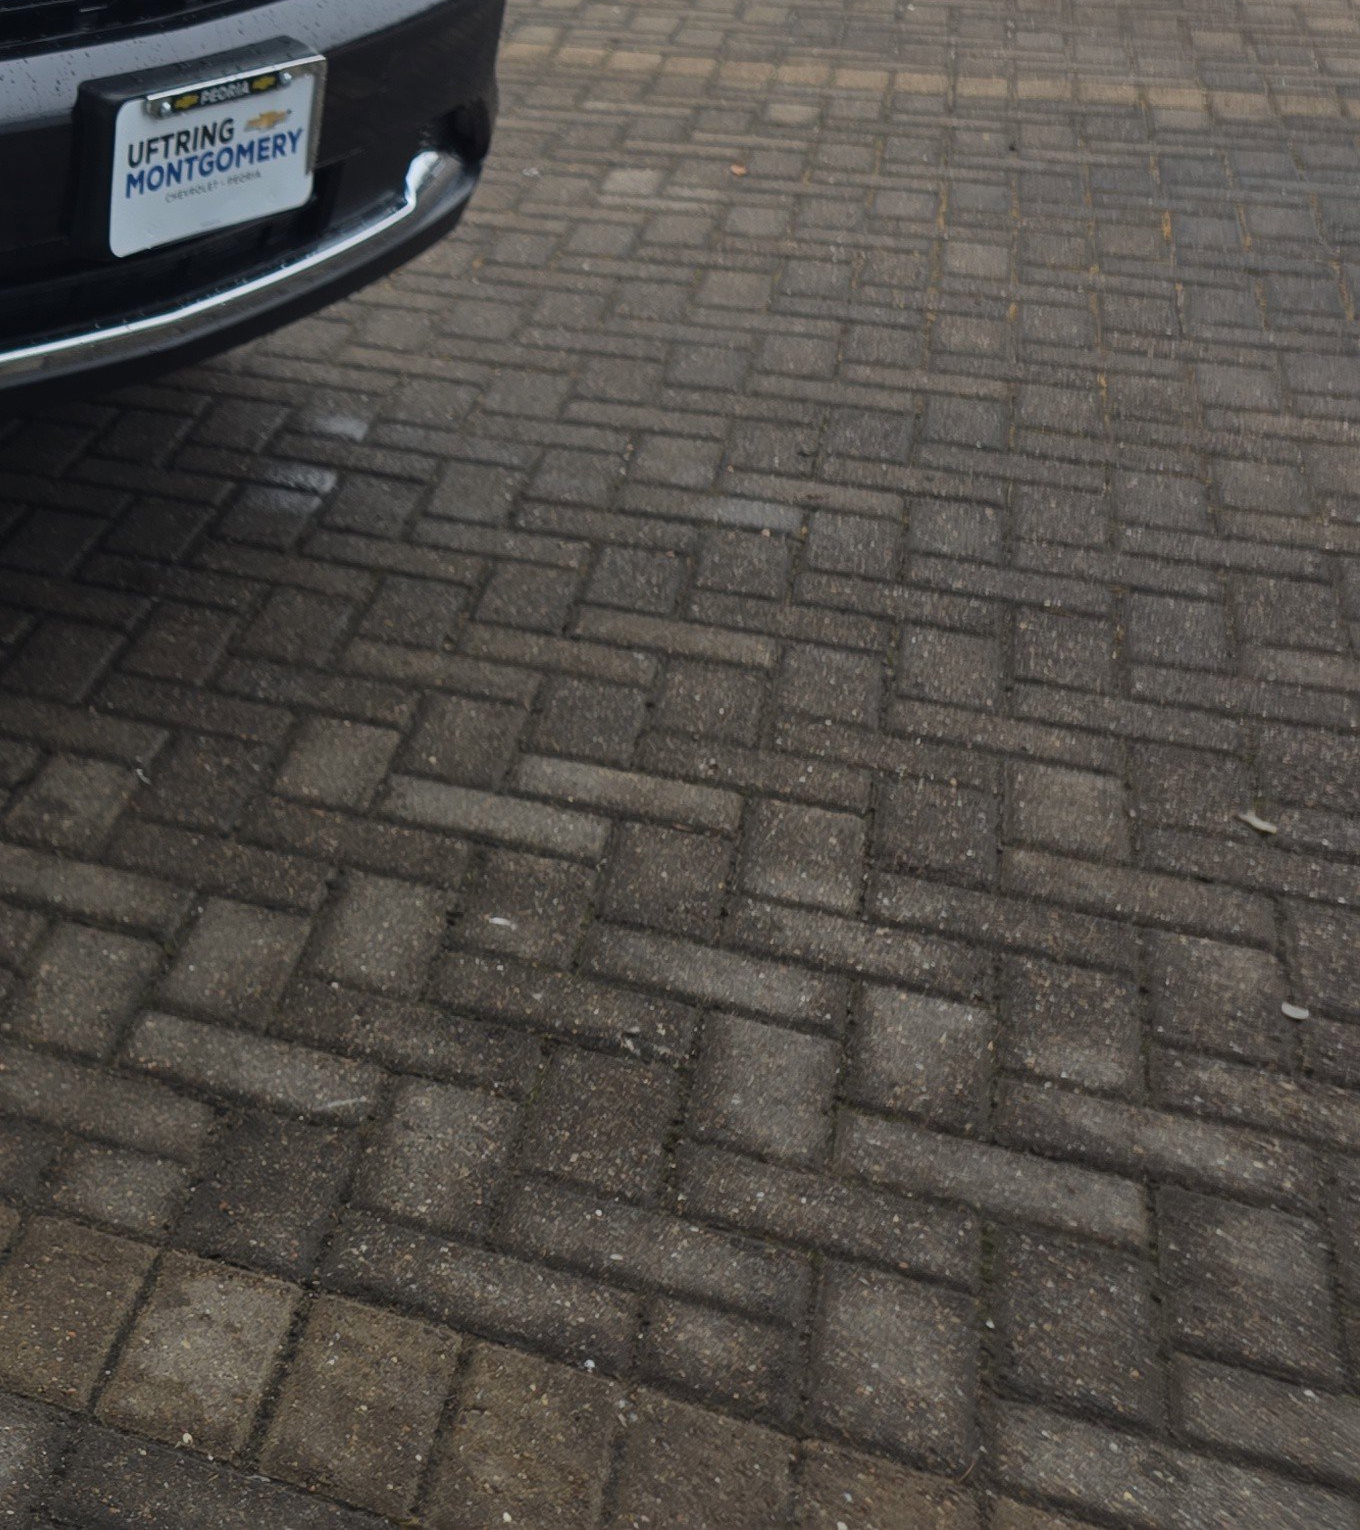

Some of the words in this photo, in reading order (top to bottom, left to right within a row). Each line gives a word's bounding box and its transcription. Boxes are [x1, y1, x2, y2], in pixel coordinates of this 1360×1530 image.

[200, 80, 250, 106] PEORIA
[125, 127, 305, 199] MONTGOMERY
[127, 117, 235, 168] UFTRING
[164, 179, 219, 203] CHEVROLET
[226, 169, 262, 186] PEORIA
